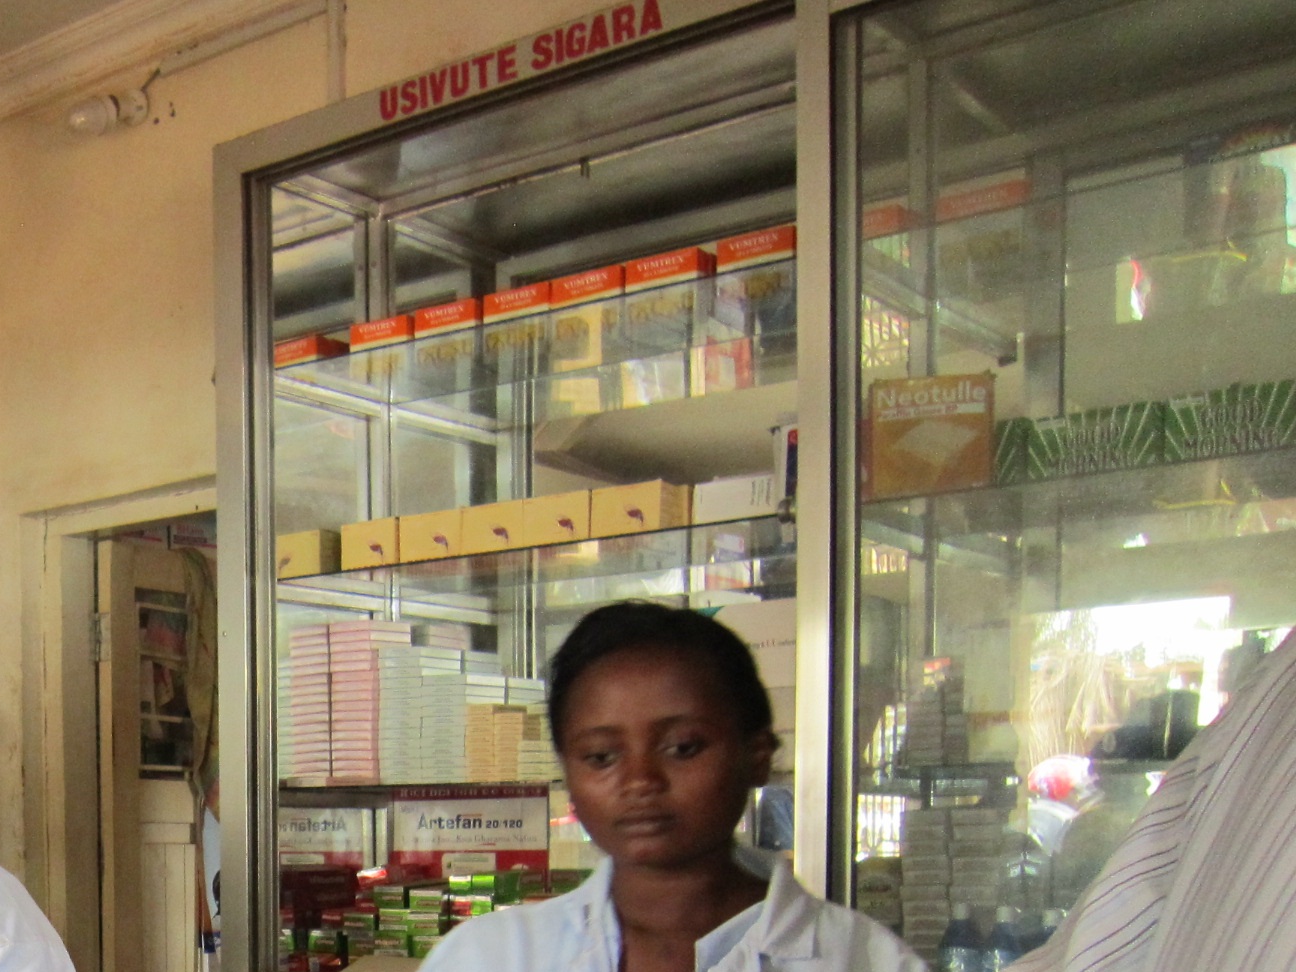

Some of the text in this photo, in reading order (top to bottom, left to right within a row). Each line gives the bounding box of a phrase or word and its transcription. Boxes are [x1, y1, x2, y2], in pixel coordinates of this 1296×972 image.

[379, 0, 663, 121] USIVUTE SIGARA
[418, 813, 482, 830] Artefan
